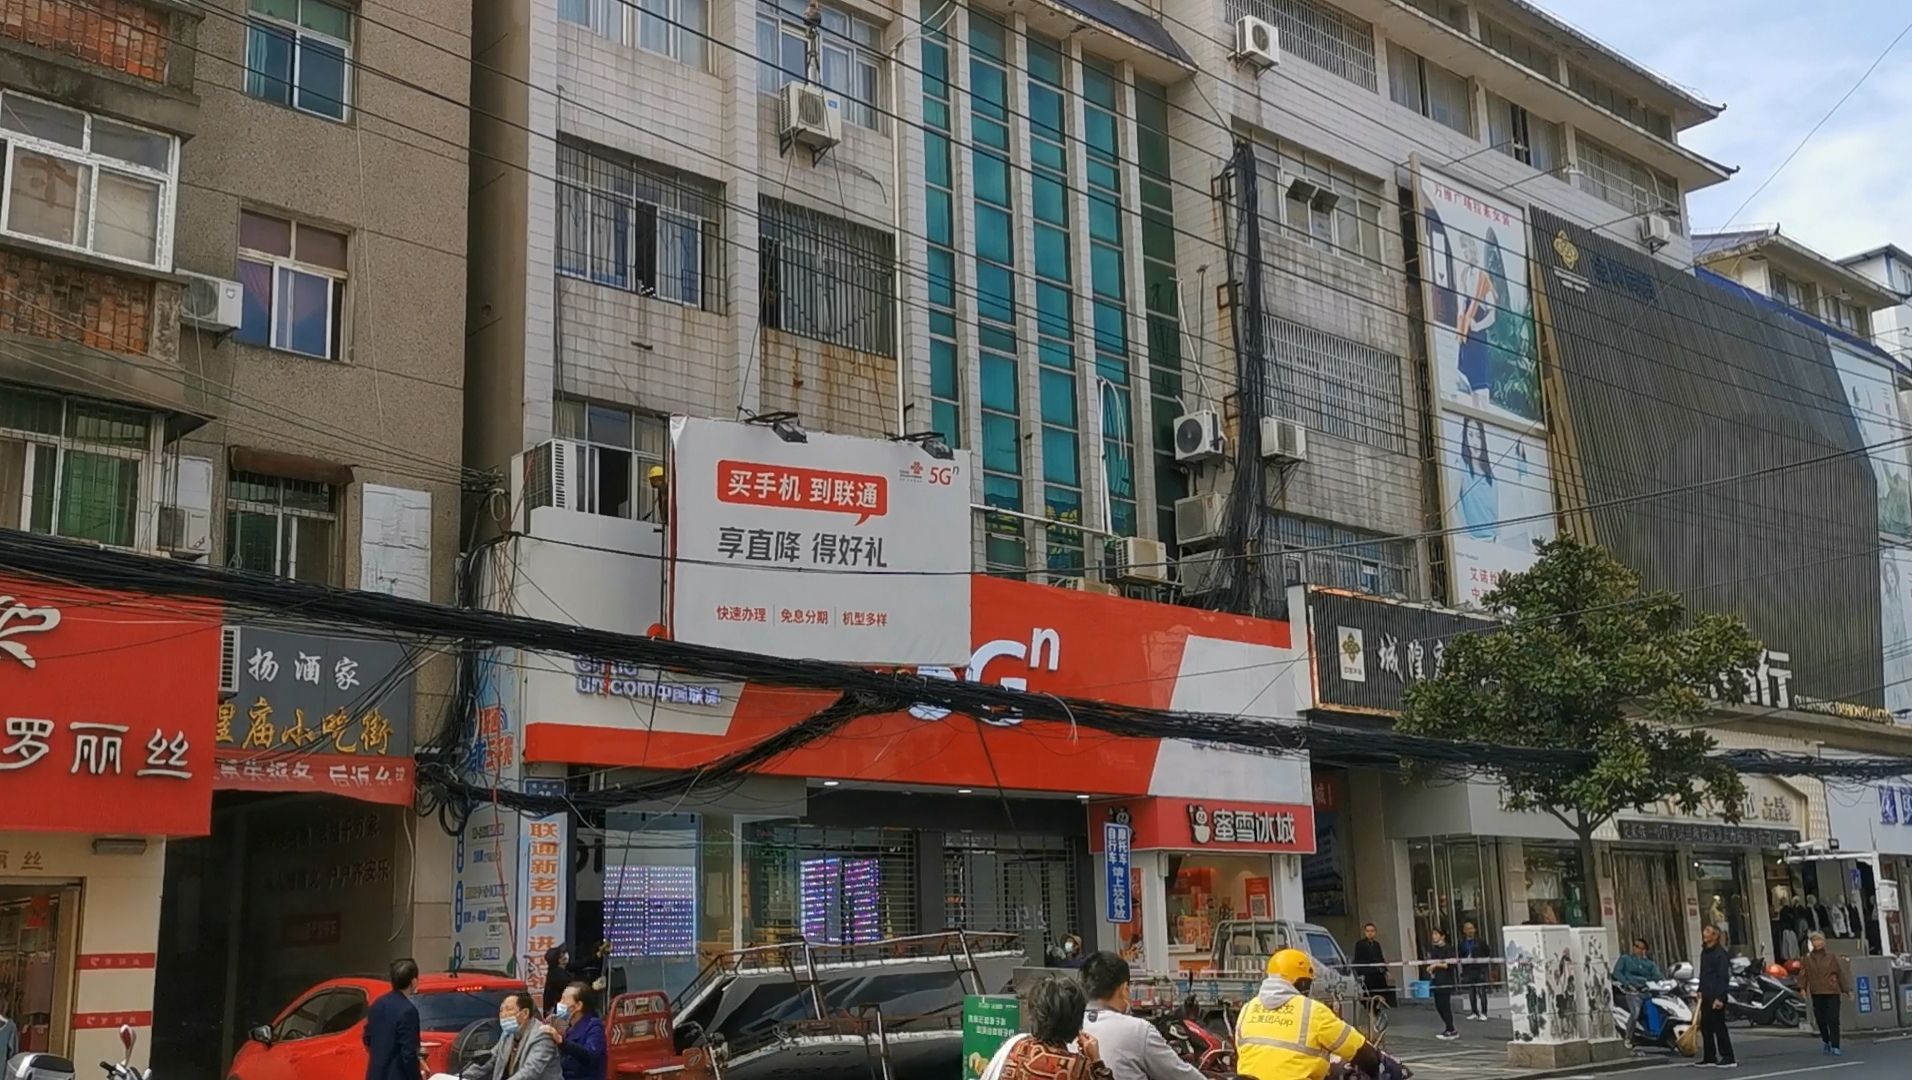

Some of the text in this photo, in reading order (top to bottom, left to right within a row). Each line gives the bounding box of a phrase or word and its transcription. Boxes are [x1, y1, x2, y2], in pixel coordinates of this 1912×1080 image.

[728, 470, 878, 509] 买手机 到联通
[717, 526, 888, 568] 享直降 得好礼
[717, 606, 887, 627] 快速办理 免息分期 机型多样
[248, 648, 360, 691] 扬酒家
[1213, 807, 1297, 844] 蜜雪冰城
[1108, 827, 1117, 865] 自行车
[529, 823, 559, 929] 联通新老用户
